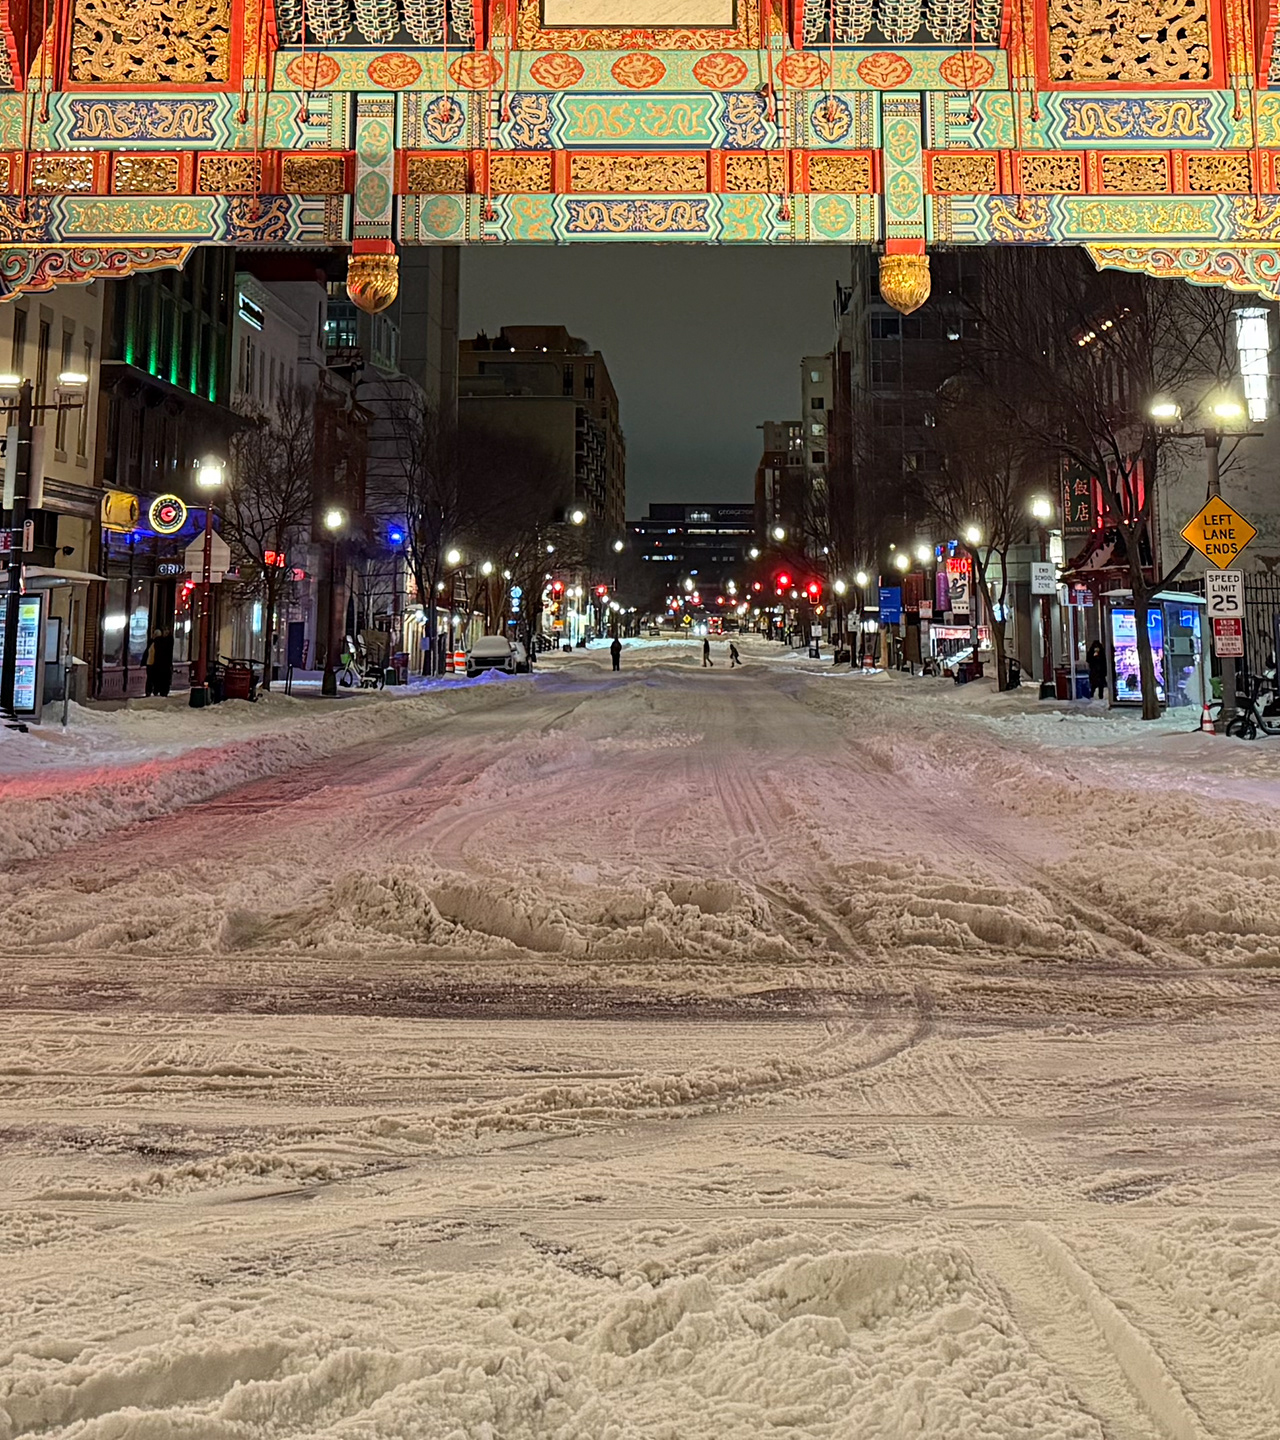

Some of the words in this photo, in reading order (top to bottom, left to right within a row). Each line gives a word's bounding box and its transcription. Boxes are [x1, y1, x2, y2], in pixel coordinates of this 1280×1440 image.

[1204, 514, 1232, 526] LEFT
[1203, 529, 1236, 540] LANE
[1206, 543, 1239, 554] ENDS
[1208, 574, 1240, 583] SPEED
[1212, 584, 1237, 592] LIMIT
[1212, 594, 1238, 611] 25
